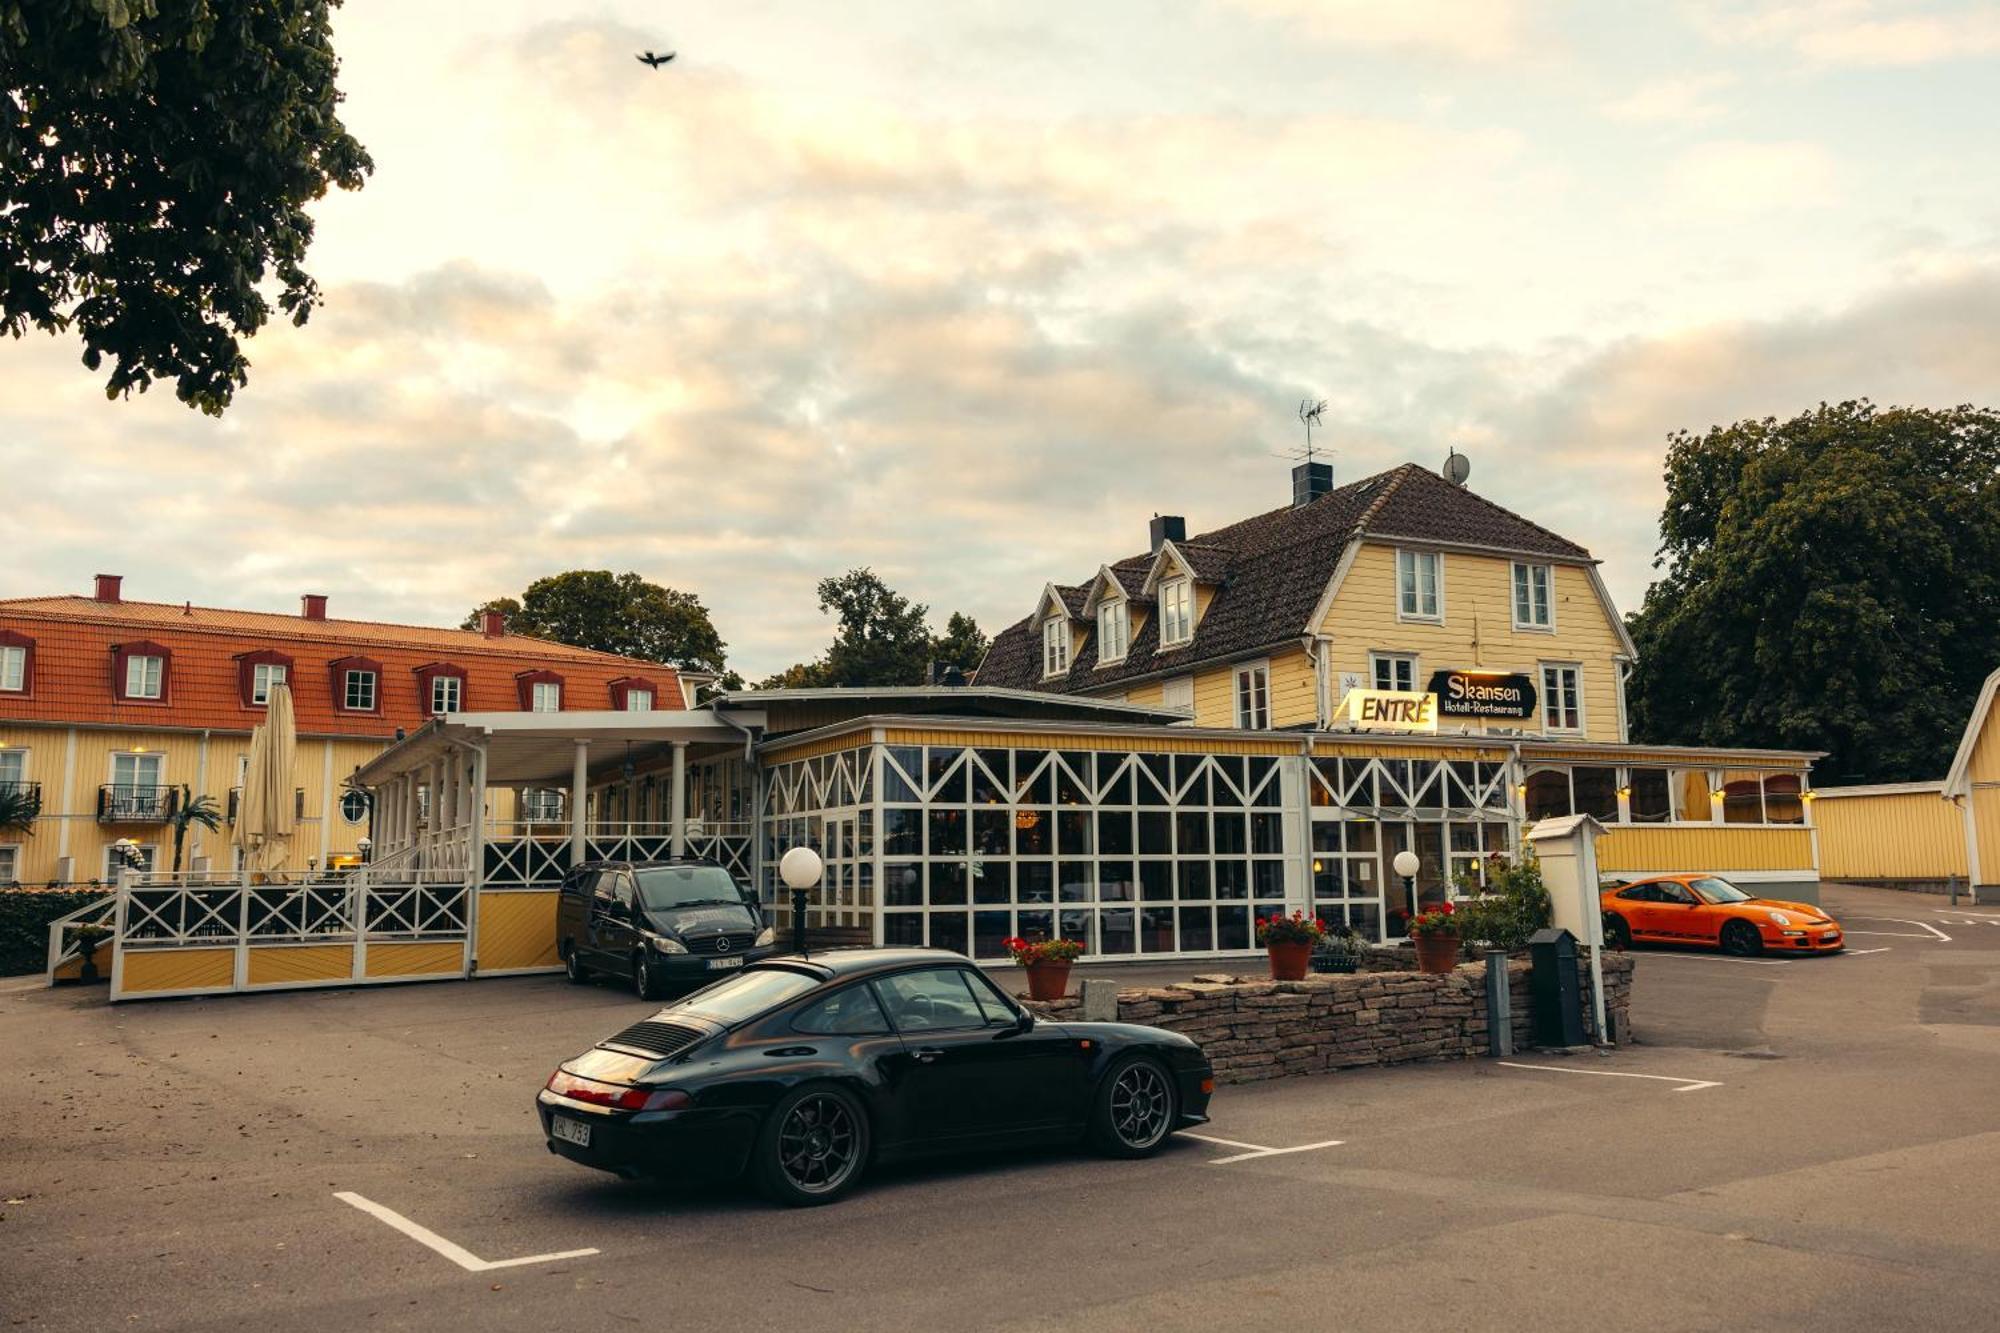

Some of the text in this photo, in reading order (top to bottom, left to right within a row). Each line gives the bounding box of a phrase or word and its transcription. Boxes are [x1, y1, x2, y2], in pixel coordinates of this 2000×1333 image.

[1447, 675, 1521, 702] Skansen
[1361, 694, 1432, 723] ENTRÉ
[1444, 700, 1524, 717] Hotell-Restaurang
[571, 1122, 589, 1143] 753
